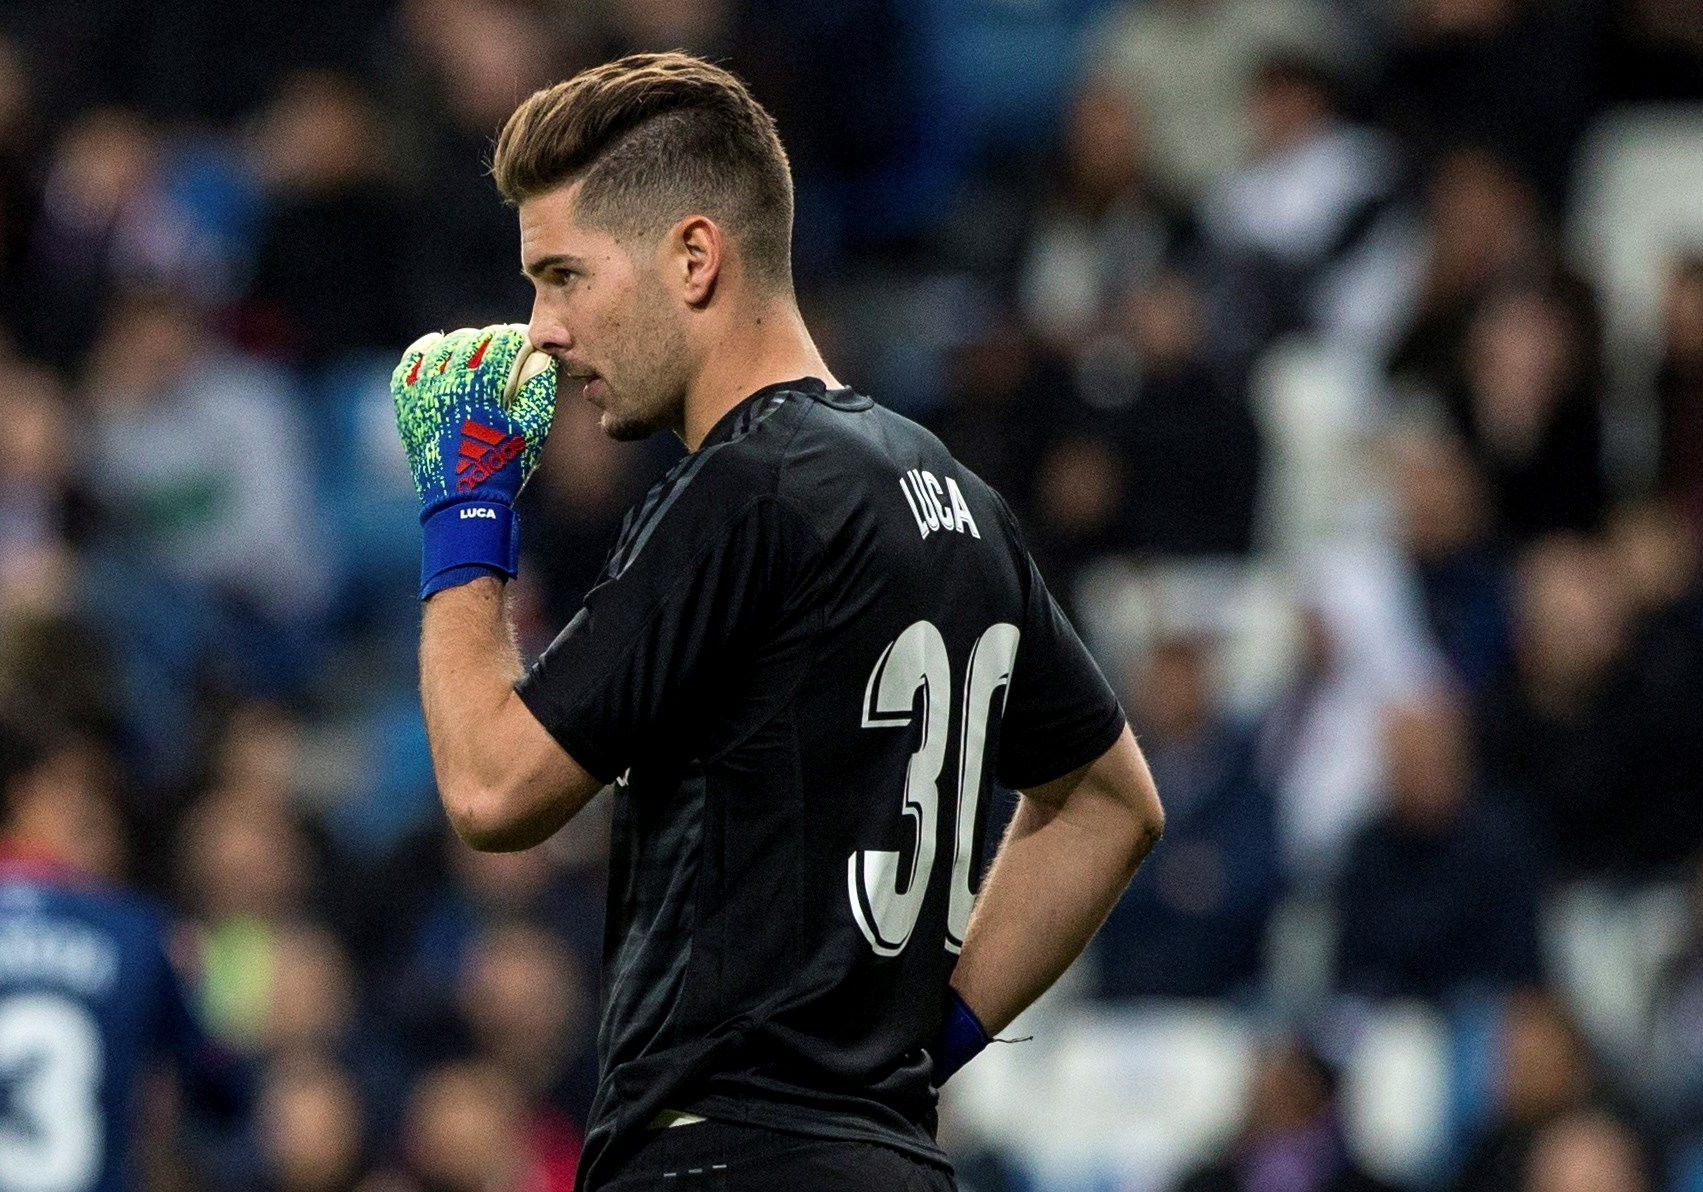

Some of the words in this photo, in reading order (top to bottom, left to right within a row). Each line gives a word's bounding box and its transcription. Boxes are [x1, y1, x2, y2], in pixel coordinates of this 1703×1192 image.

[456, 434, 526, 493] adidas
[459, 507, 496, 520] LUCA
[899, 468, 981, 540] LUCA
[848, 620, 1021, 957] 30
